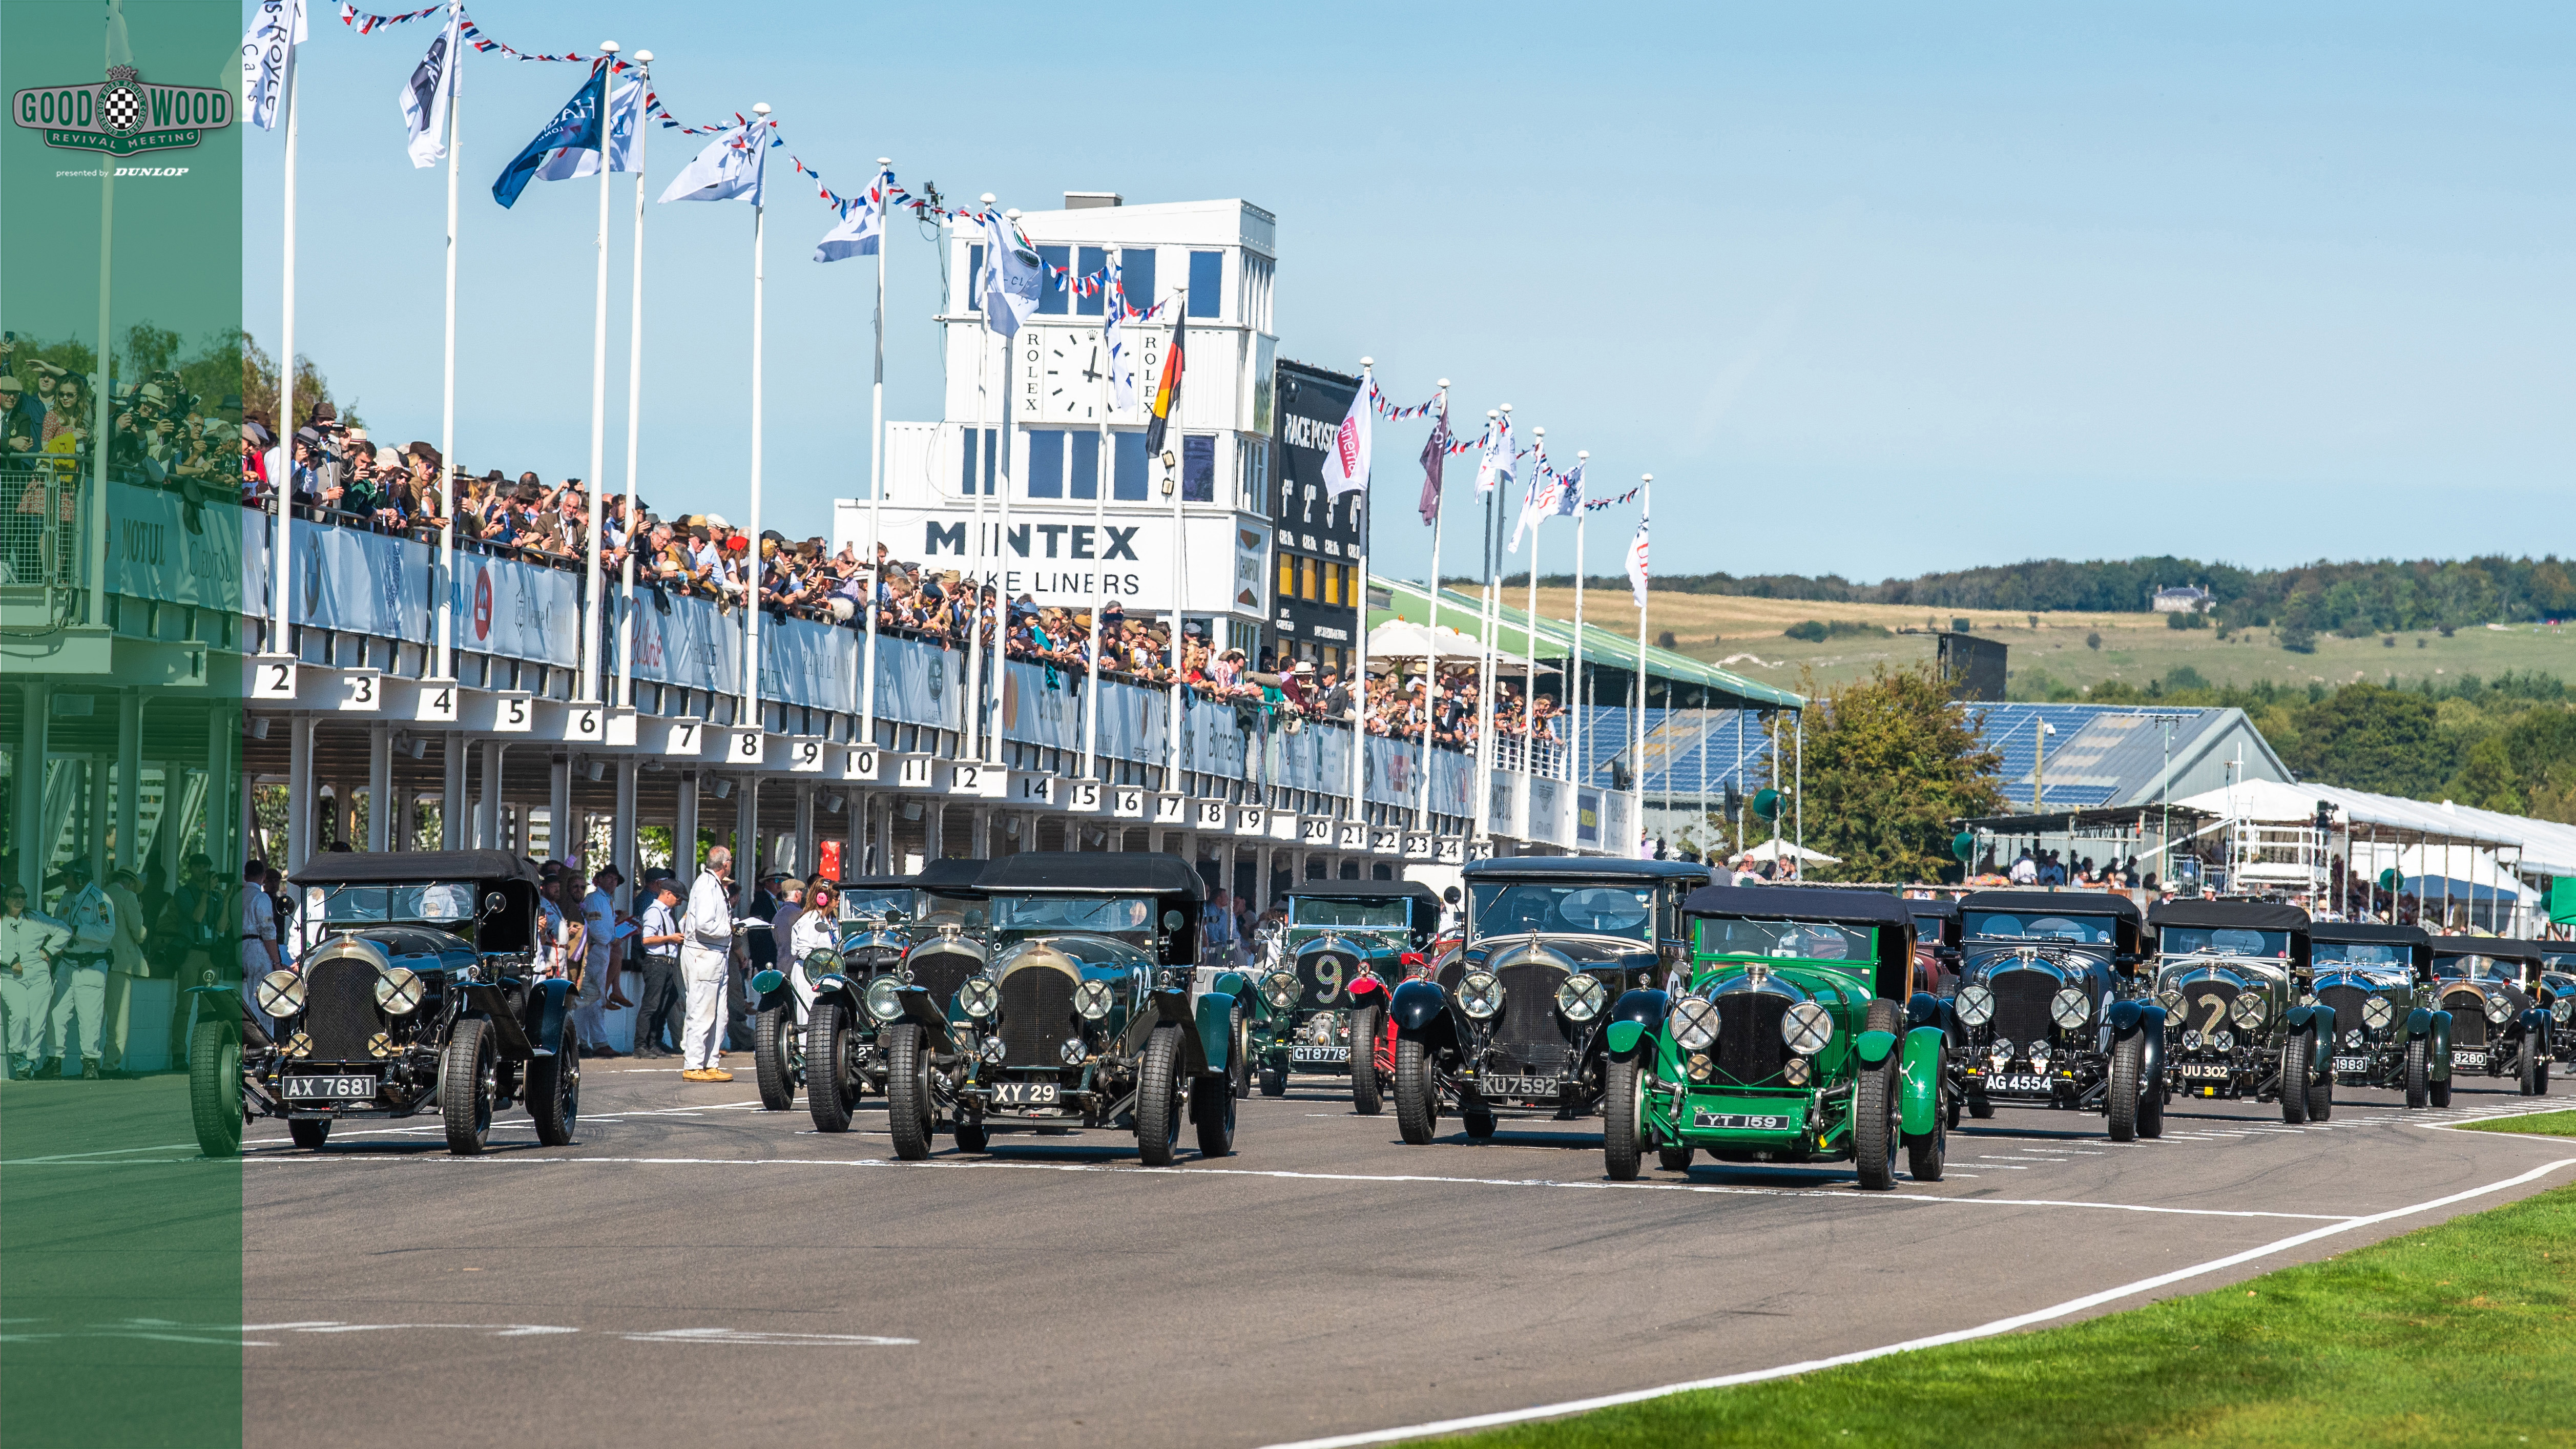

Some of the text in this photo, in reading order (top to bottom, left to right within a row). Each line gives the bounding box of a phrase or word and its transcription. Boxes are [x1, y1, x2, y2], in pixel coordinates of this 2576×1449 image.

[264, 0, 287, 111] s-Royce
[242, 44, 258, 102] Cars
[1027, 333, 1040, 410] ROLEX
[1143, 337, 1157, 414] ROLEX
[1284, 413, 1310, 448] RACE
[122, 518, 165, 566] MOTUL
[925, 521, 1140, 561] MNTEX
[1035, 572, 1139, 595] LINERS
[271, 665, 289, 690] 2
[356, 676, 371, 702] 3
[433, 688, 451, 713] 4
[510, 699, 525, 723] 5
[580, 710, 596, 733] 6
[680, 724, 695, 747] 7
[742, 734, 757, 756] 8
[803, 742, 818, 764] 9
[846, 752, 872, 774] 10
[906, 759, 925, 781] 11
[952, 767, 977, 788] 12
[1024, 778, 1048, 799] 14
[1073, 785, 1095, 805] 15
[1115, 791, 1138, 811] 16
[1156, 798, 1179, 816] 17
[1198, 803, 1221, 822] 18
[1238, 811, 1260, 829] 19
[1302, 821, 1327, 839] 20
[1341, 826, 1362, 843] 21
[1372, 832, 1395, 848] 22
[1406, 837, 1427, 853] 23
[1435, 841, 1458, 857] 24
[1468, 846, 1488, 861] 25
[1315, 955, 1342, 1004] 9
[2197, 993, 2227, 1045] 2
[1295, 1048, 1346, 1060] GT8779
[2336, 1059, 2363, 1070] 1983
[2454, 1054, 2484, 1063] 8280
[2183, 1065, 2228, 1078] UU 302
[288, 1078, 370, 1096] AX 7681
[995, 1085, 1055, 1102] XY 29
[1482, 1078, 1557, 1095] KU7592
[1986, 1077, 2052, 1090] AG 4554
[1707, 1115, 1777, 1127] YT 159
